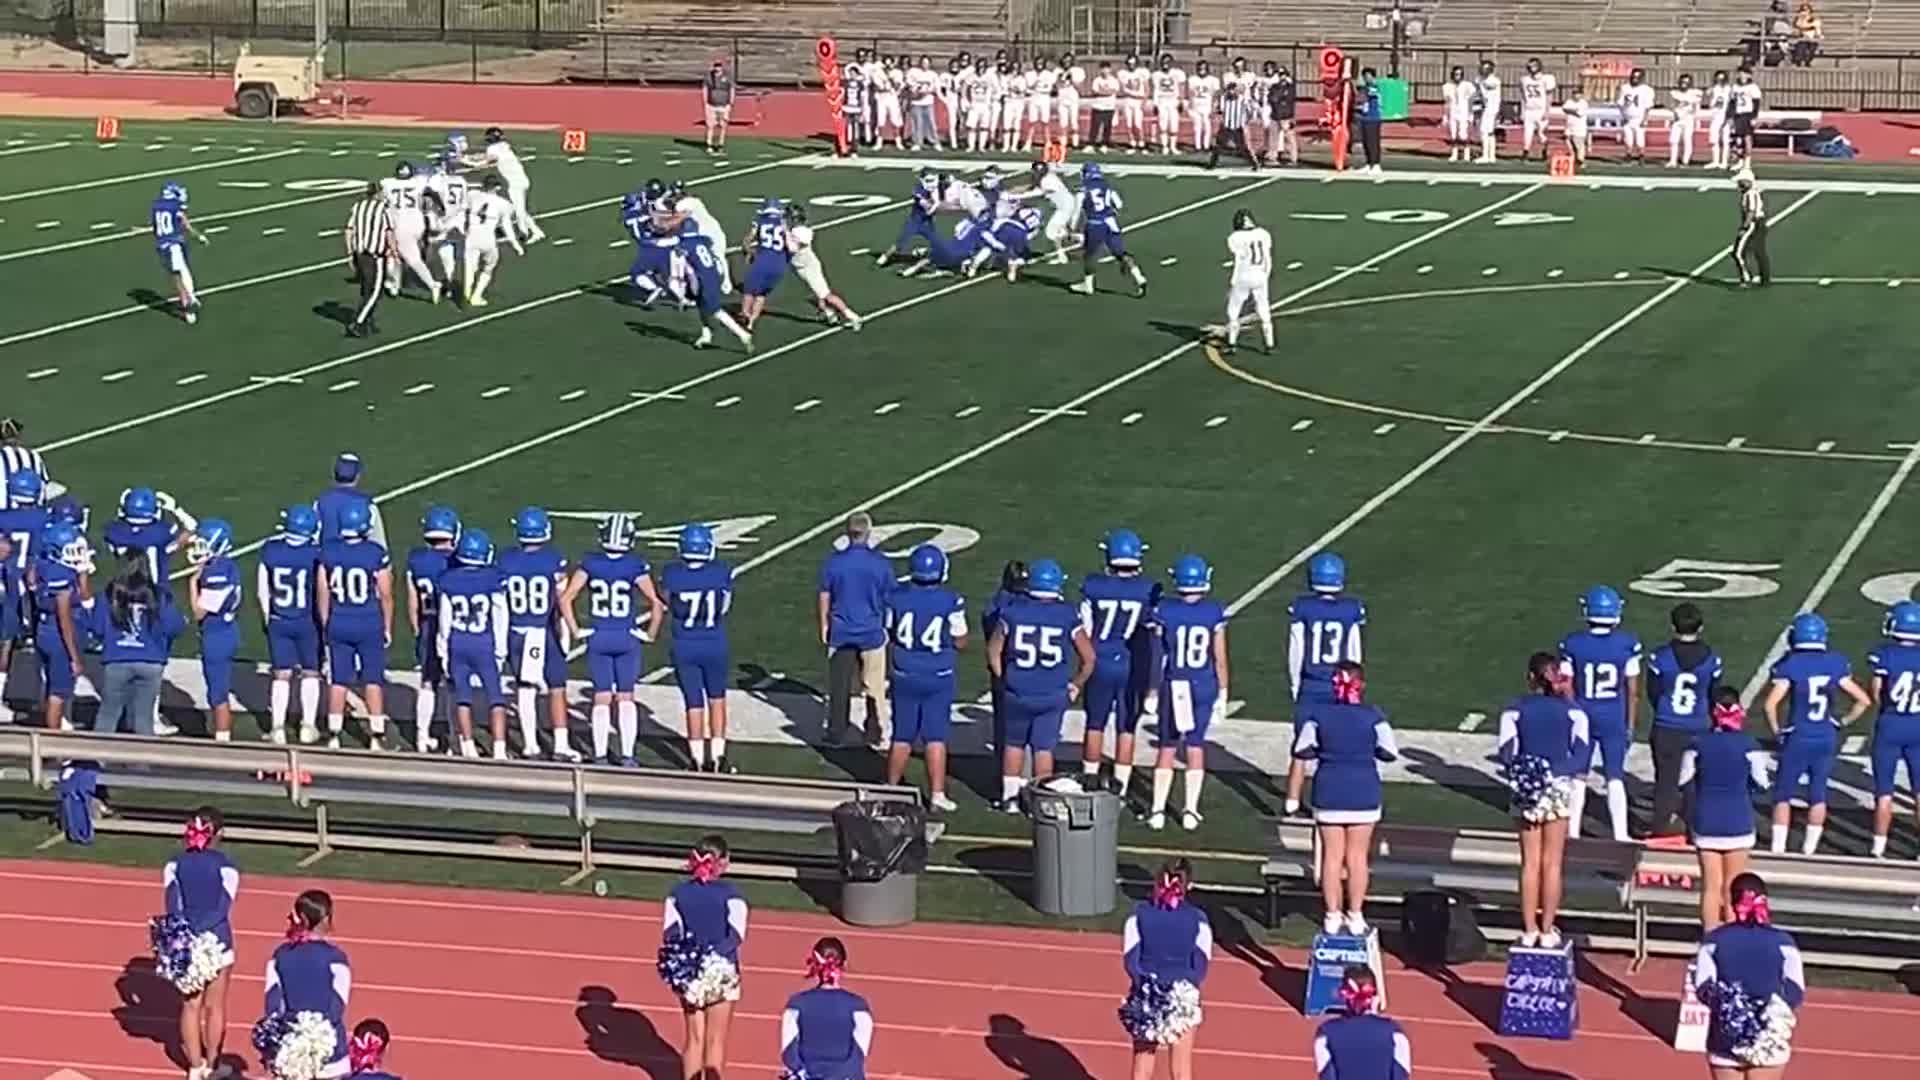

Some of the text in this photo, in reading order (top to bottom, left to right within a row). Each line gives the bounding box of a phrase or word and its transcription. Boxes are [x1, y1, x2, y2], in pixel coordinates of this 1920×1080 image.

[391, 187, 416, 209] 75
[477, 203, 490, 224] 4
[155, 211, 173, 235] 10
[759, 223, 785, 251] 55
[1248, 241, 1265, 265] 11
[273, 568, 306, 609] 51
[330, 566, 368, 604] 40
[509, 576, 550, 615] 88
[591, 581, 631, 618] 26
[452, 594, 490, 633] 23
[680, 592, 716, 628] 71
[1098, 601, 1142, 640] 77
[897, 616, 943, 653] 44
[1014, 626, 1062, 667] 55
[1176, 626, 1211, 669] 18
[1312, 622, 1342, 665] 13
[529, 647, 541, 660] G
[1585, 663, 1619, 699] 12
[1671, 673, 1698, 715] 6
[1807, 676, 1831, 720] 5
